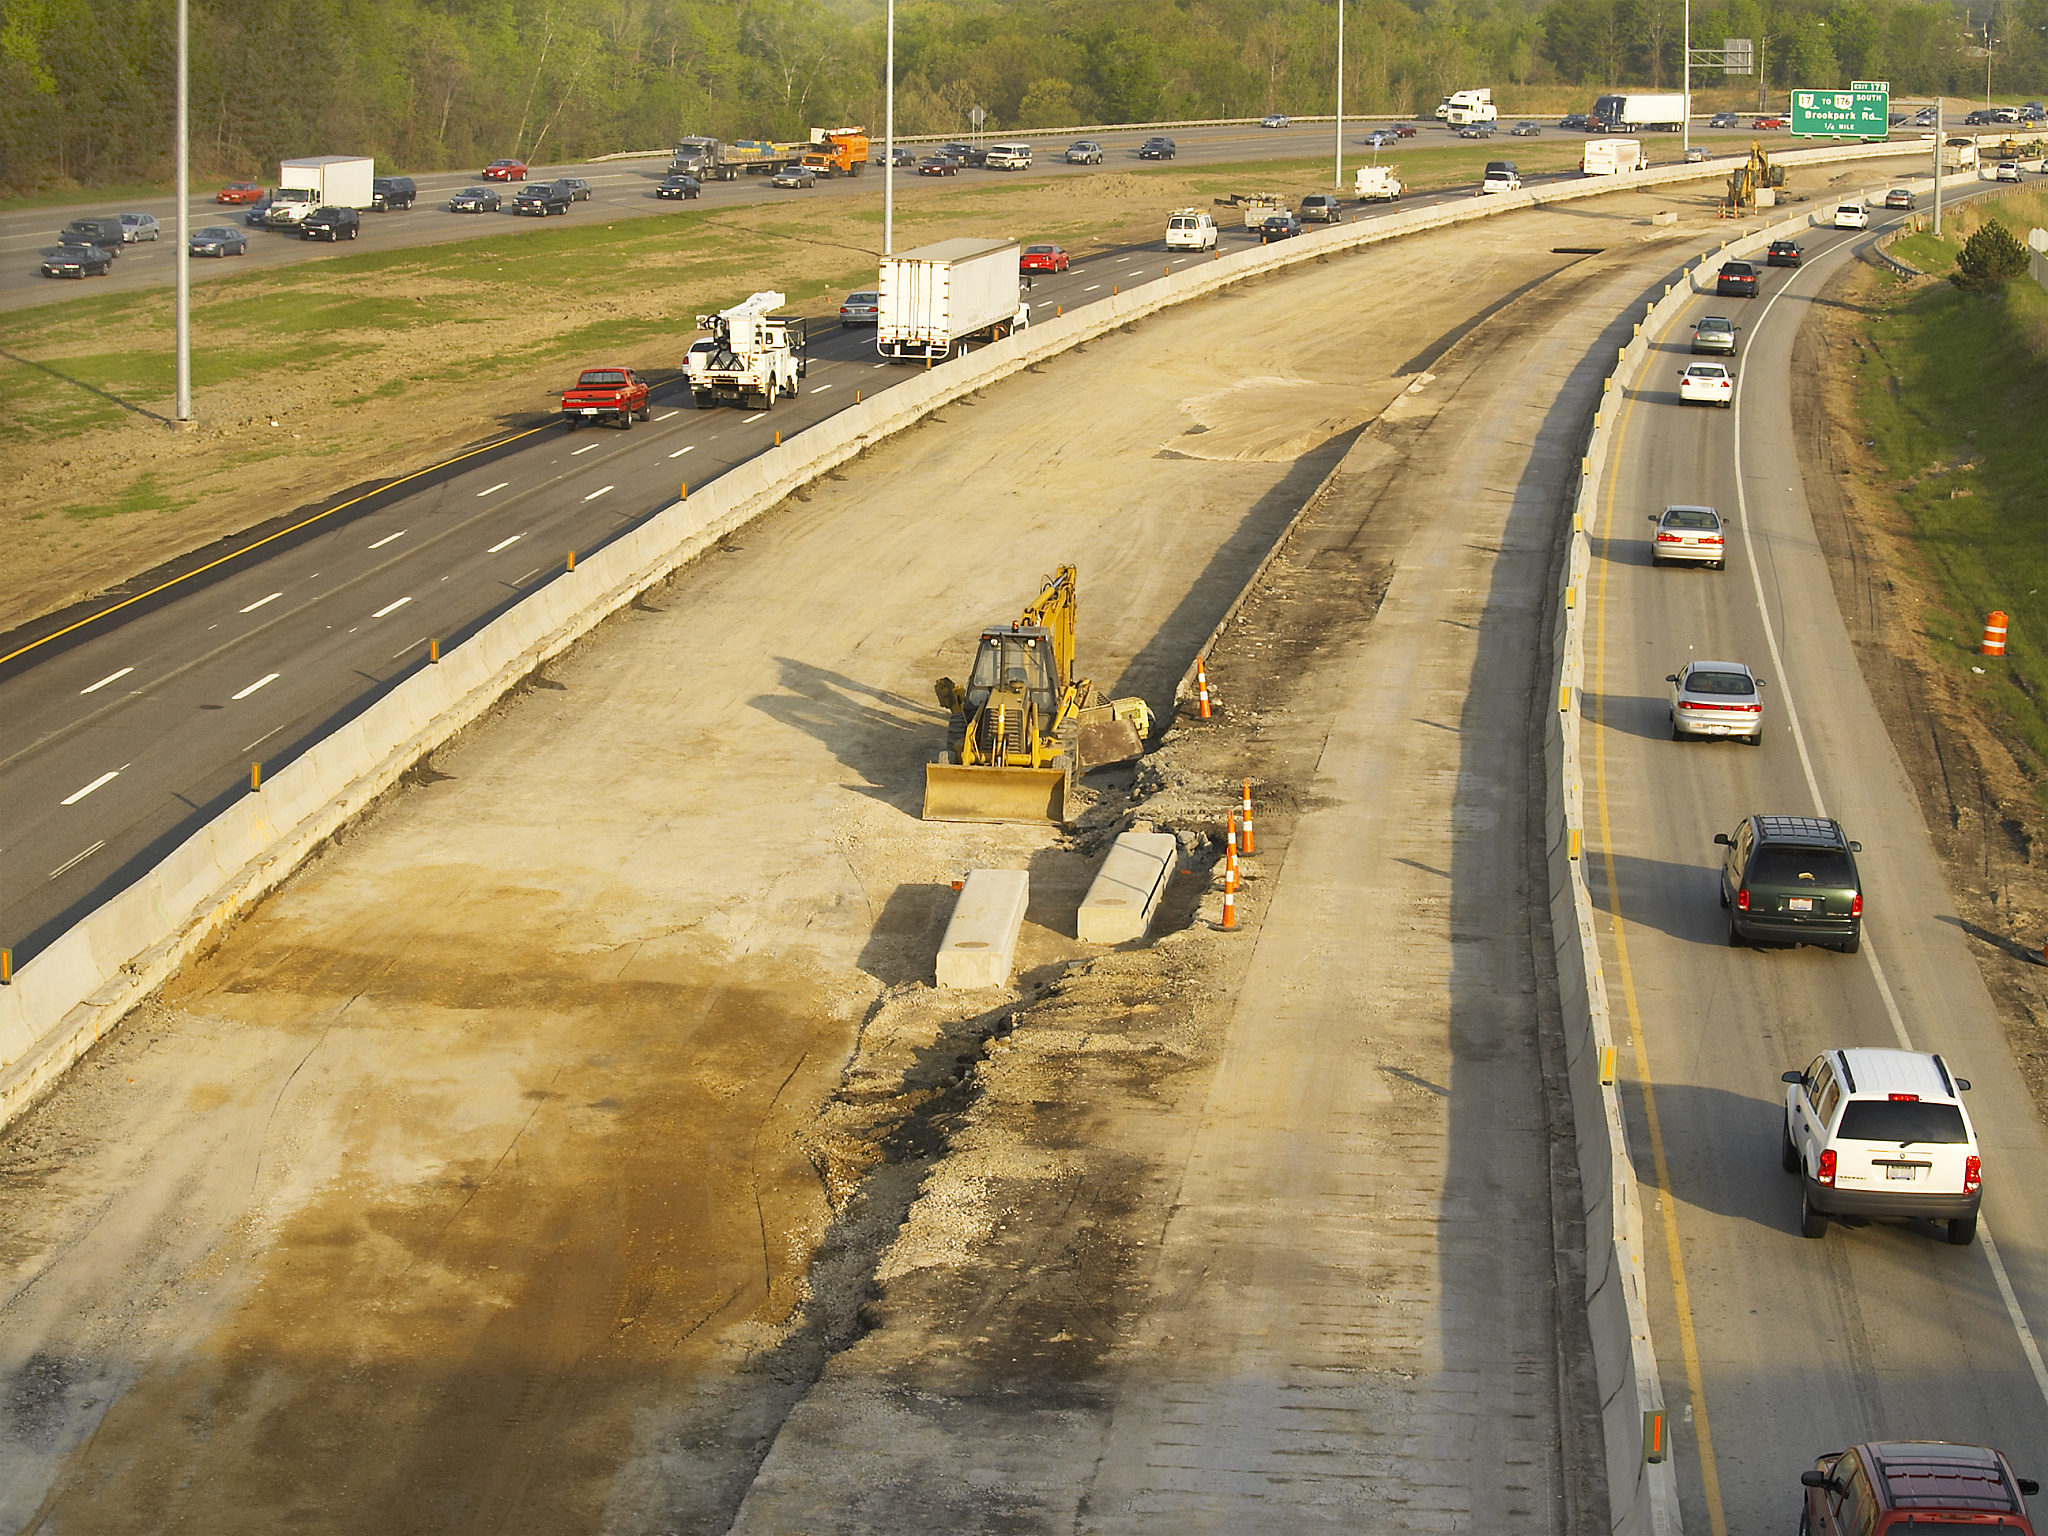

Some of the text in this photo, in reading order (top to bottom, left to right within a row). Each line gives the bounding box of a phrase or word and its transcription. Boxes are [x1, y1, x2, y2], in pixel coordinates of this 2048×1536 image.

[1801, 96, 1811, 104] 17
[1836, 97, 1851, 105] 176
[1804, 110, 1856, 121] Brookpark
